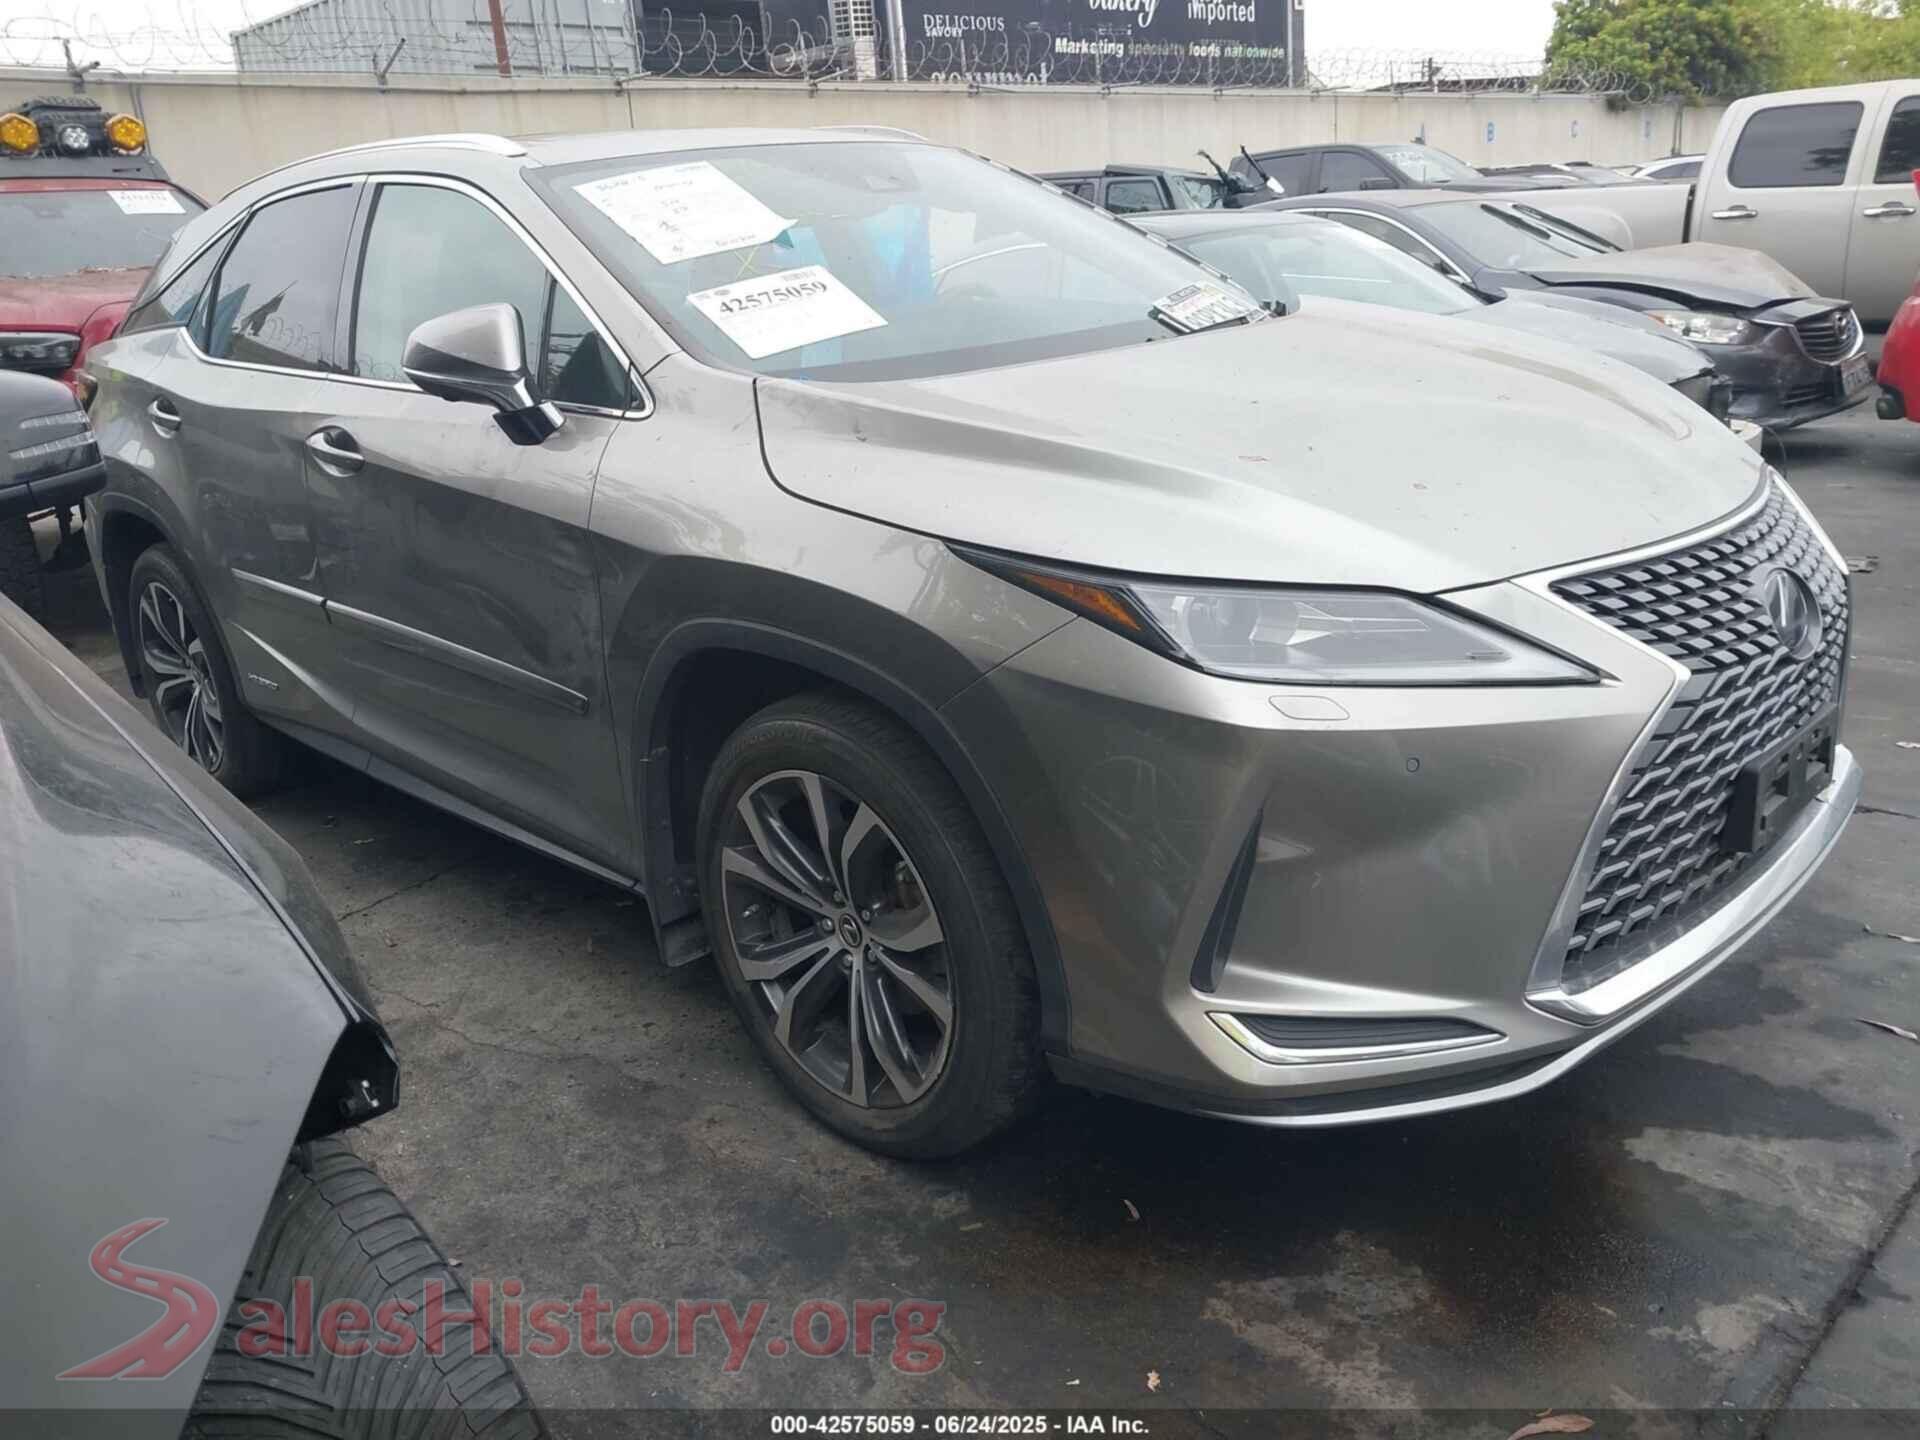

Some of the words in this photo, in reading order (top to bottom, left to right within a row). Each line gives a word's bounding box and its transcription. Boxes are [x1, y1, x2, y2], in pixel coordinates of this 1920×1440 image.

[922, 13, 1005, 32] DELICIOUS
[1055, 36, 1125, 58] Marketing
[1188, 41, 1221, 58] foods
[719, 281, 828, 314] 42575059
